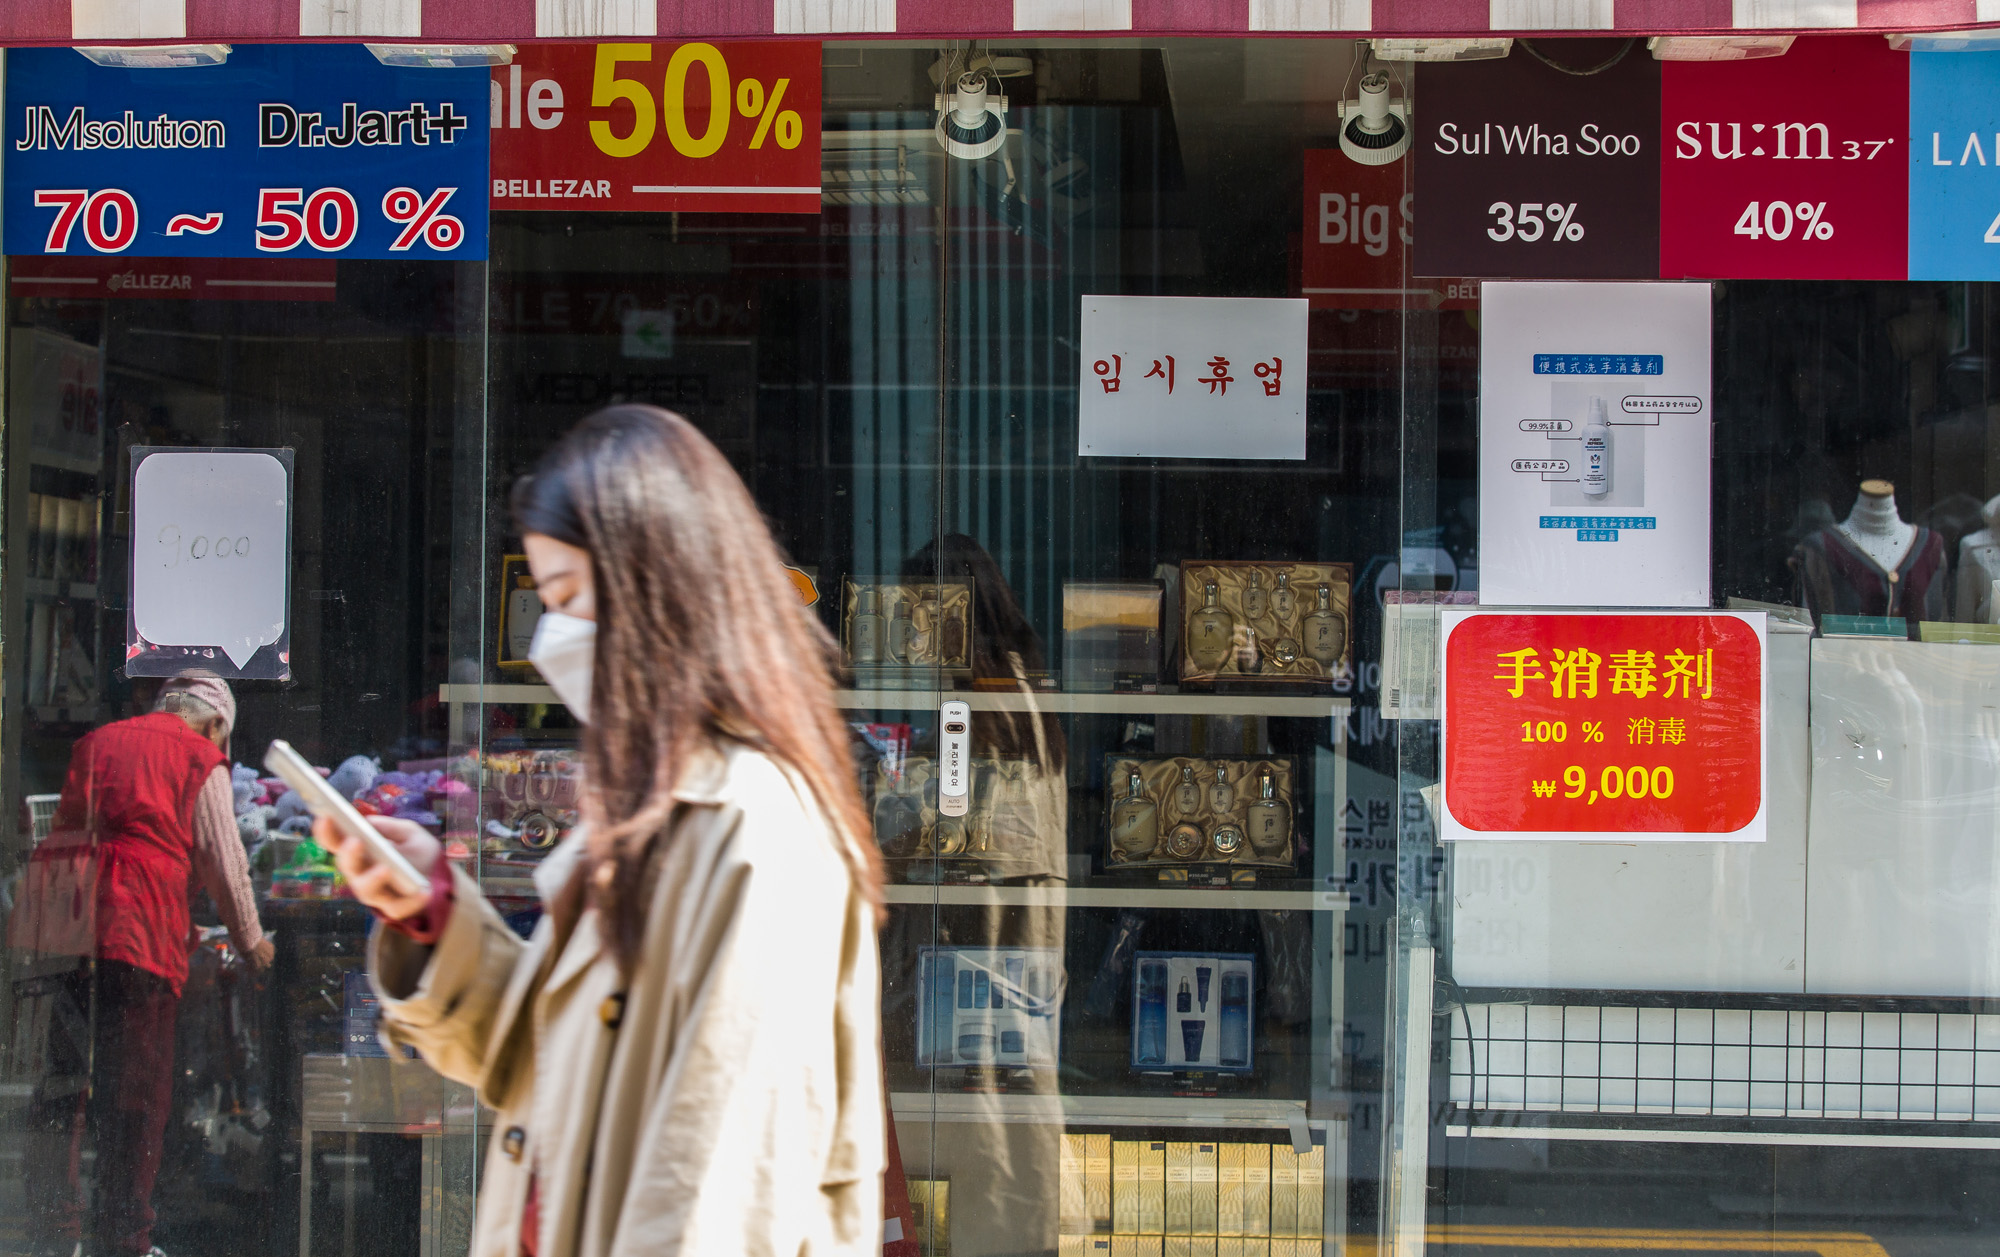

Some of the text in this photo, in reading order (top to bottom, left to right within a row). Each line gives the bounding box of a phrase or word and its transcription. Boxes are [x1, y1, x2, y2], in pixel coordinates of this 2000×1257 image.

[588, 42, 803, 159] 50%
[16, 103, 468, 151] JMsolution Dr.Jart+
[1434, 122, 1641, 156] Sul Wha Soo
[1676, 120, 1834, 160] su:m
[1932, 131, 2000, 167] LA
[492, 179, 612, 199] BELLEZAR
[34, 188, 139, 254] 70
[255, 187, 359, 253] 50
[1318, 192, 1390, 257] Big
[1487, 201, 1585, 242] 35%
[1734, 200, 1835, 241] 40%
[1493, 647, 1714, 700] 手消毒剂
[1521, 716, 1687, 745] 100 % 消毒
